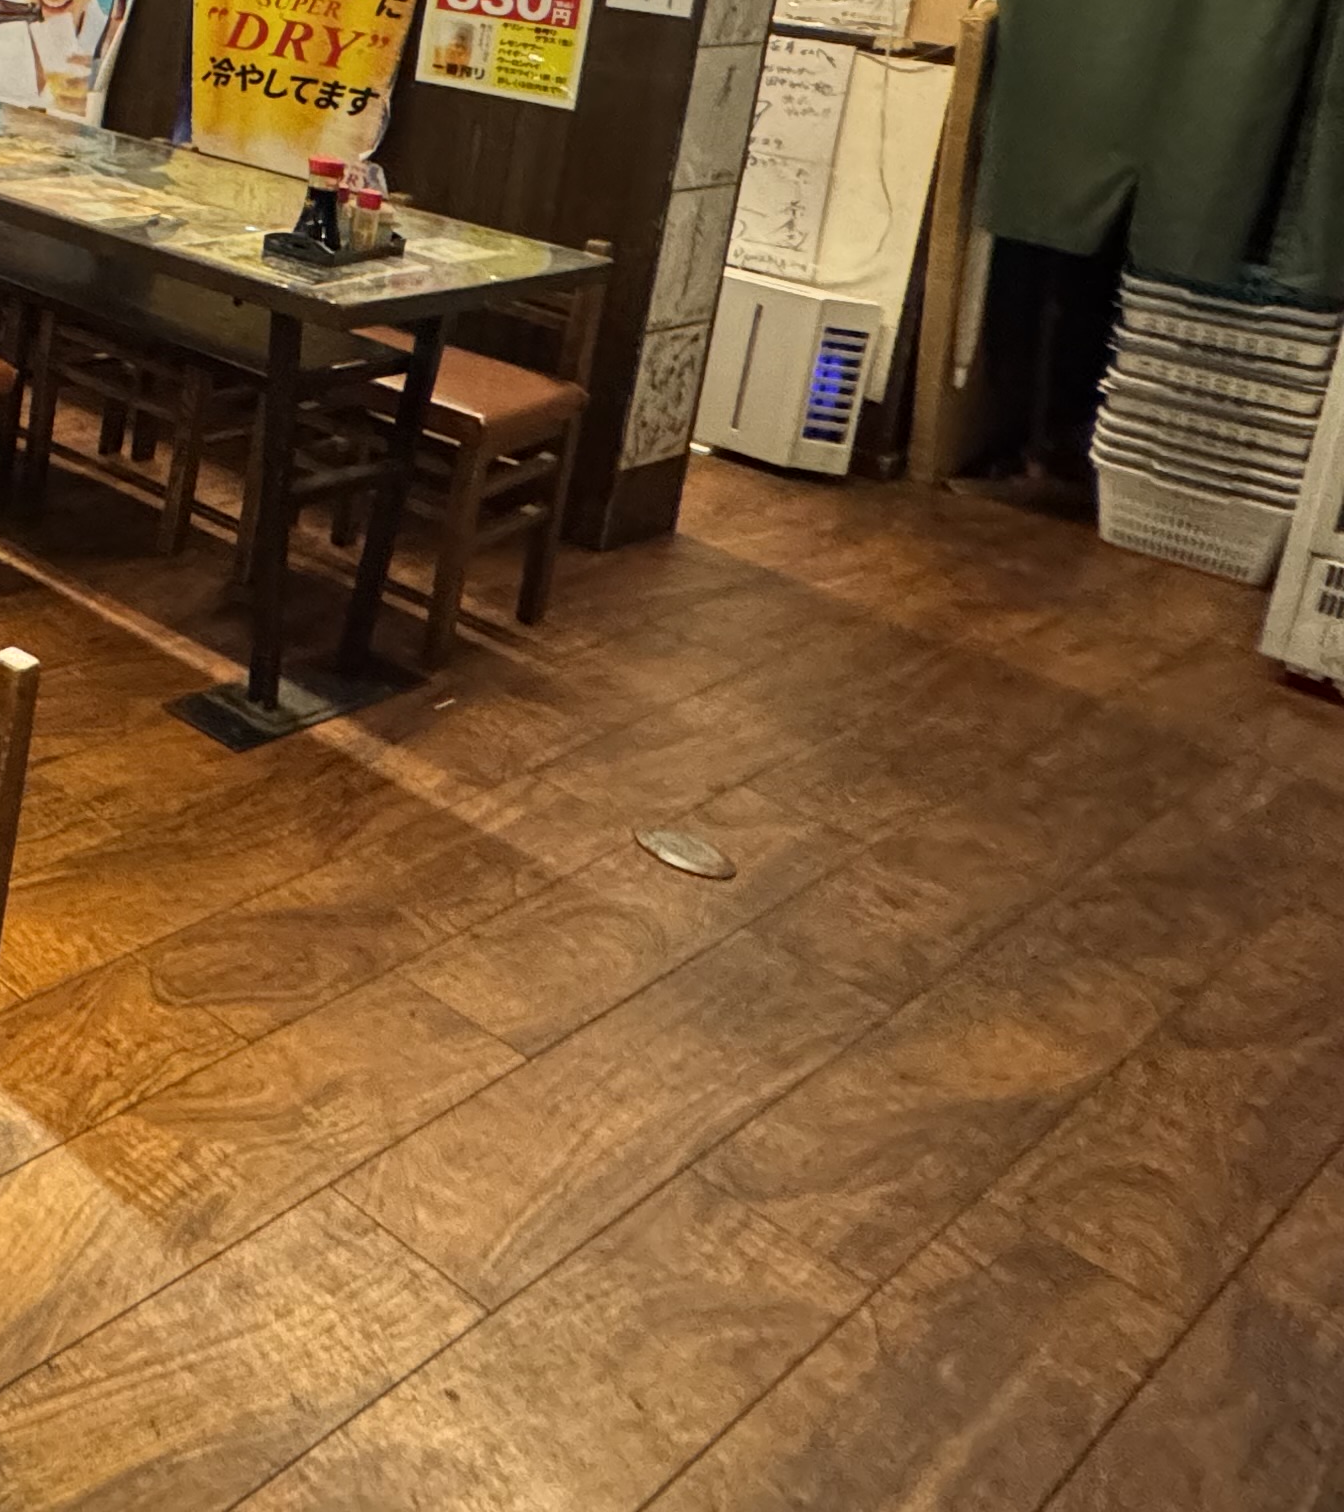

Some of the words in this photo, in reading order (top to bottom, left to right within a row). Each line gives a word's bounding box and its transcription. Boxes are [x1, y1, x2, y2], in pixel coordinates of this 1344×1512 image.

[201, 56, 381, 117] 冷やしてます
